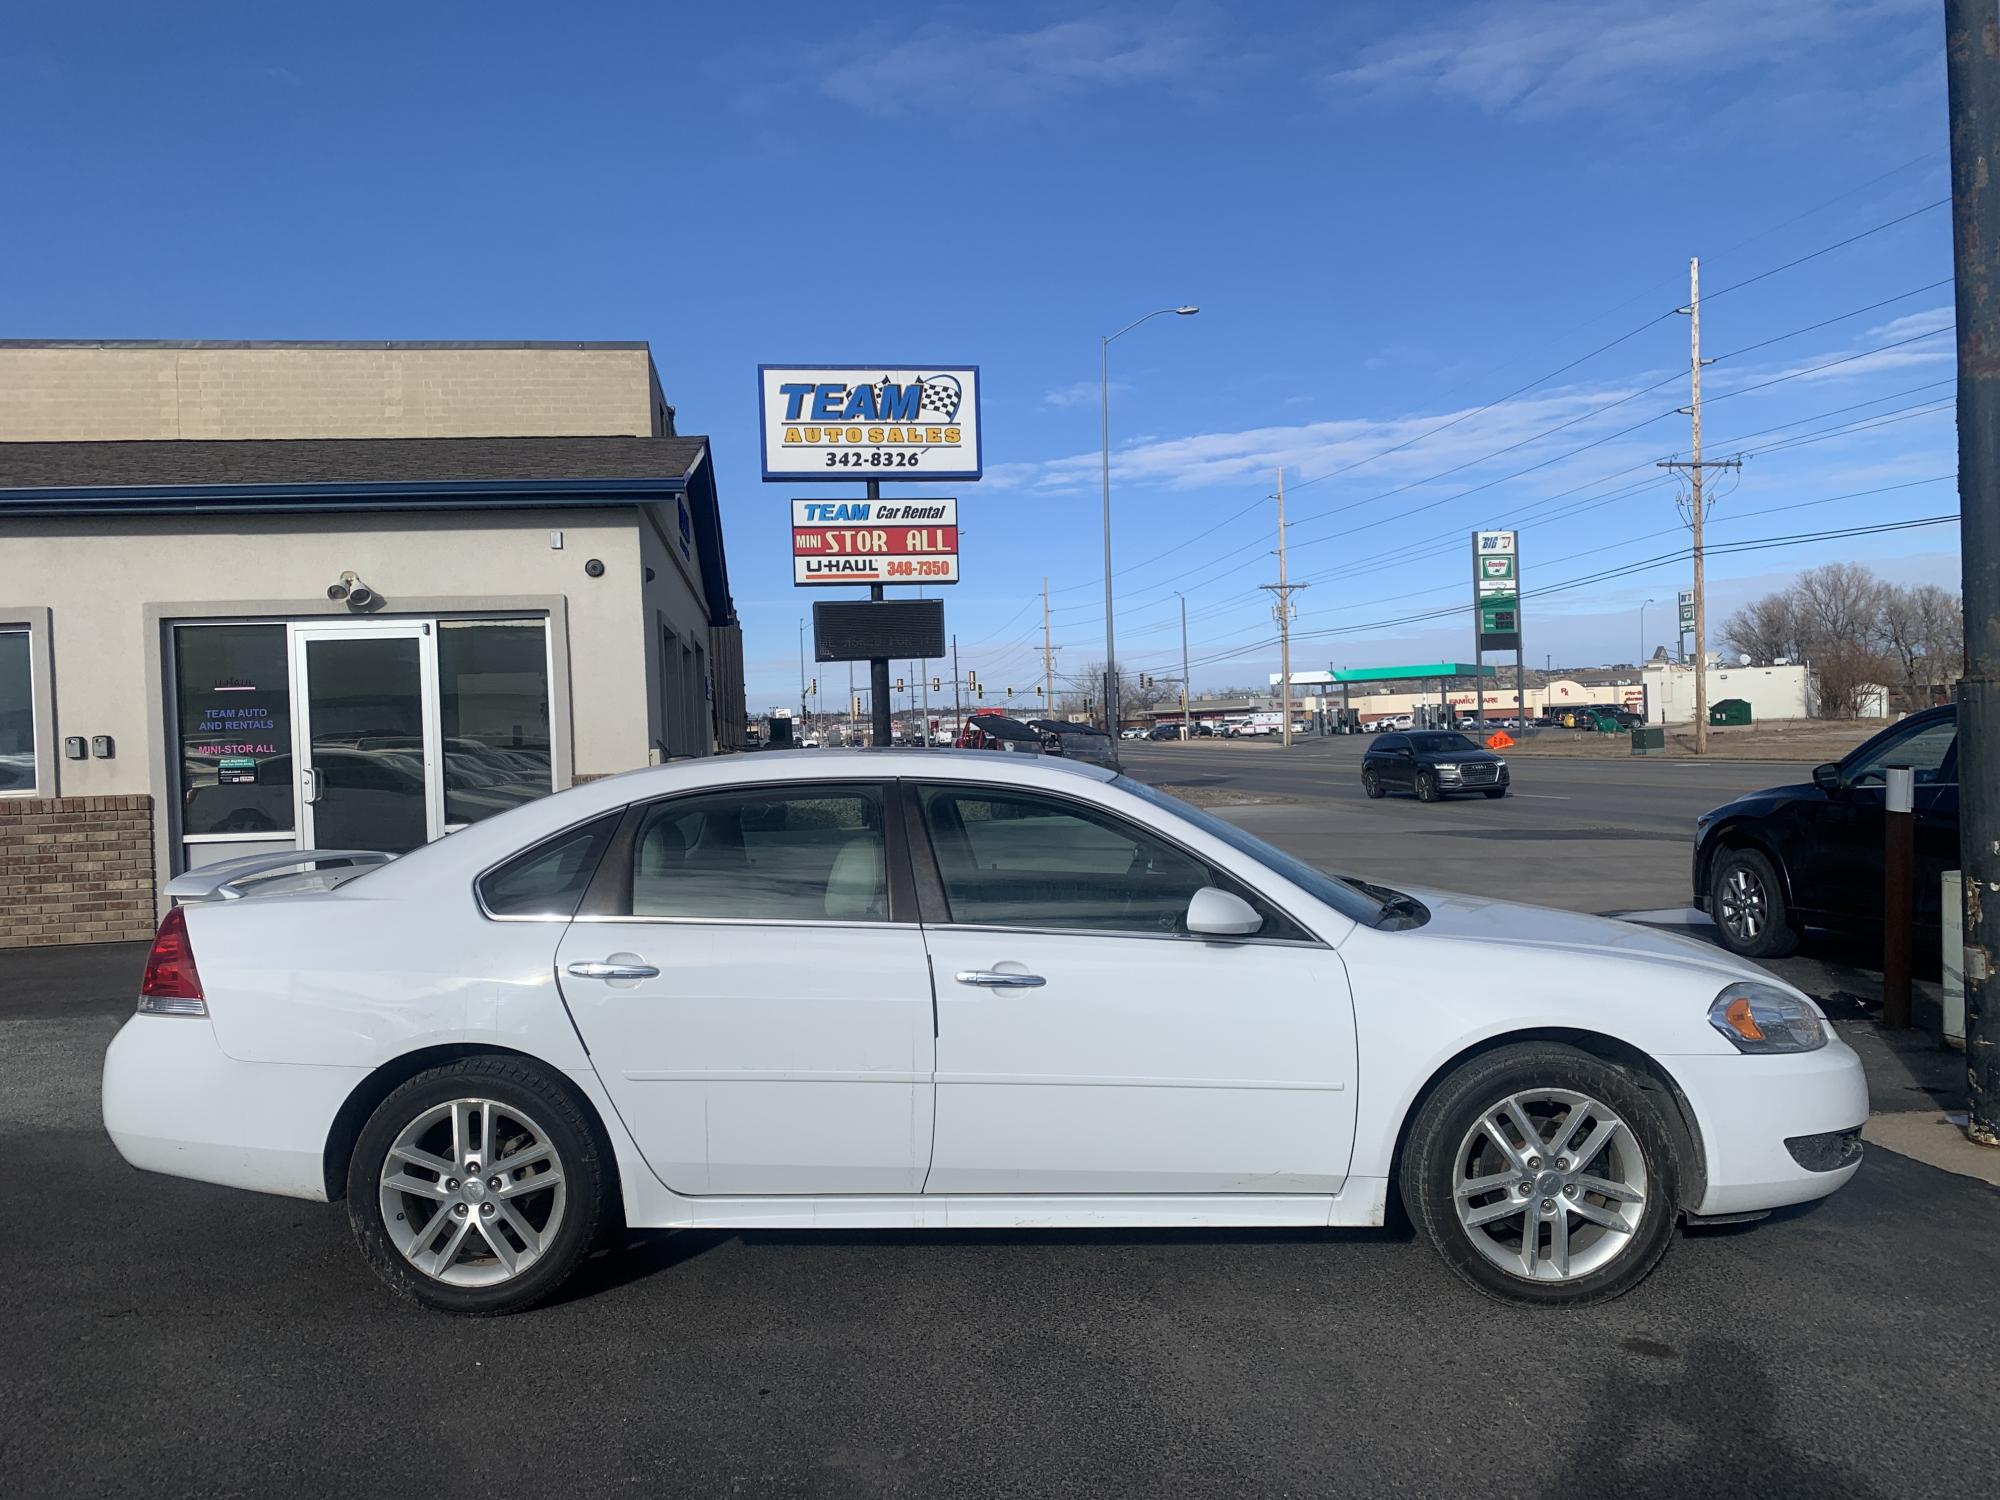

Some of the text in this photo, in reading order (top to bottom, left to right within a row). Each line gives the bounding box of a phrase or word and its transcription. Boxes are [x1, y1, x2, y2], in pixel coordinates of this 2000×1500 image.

[780, 382, 924, 421] TEAM
[825, 452, 919, 467] 342-8326
[804, 503, 946, 521] TEAM Car Rental
[796, 529, 951, 552] MINI STOR ALL
[1482, 537, 1498, 548] BIG
[806, 559, 949, 576] U-HAUL 348-7350
[205, 709, 268, 718] TEAM AUTO
[200, 721, 274, 730] AND RENTALS
[198, 745, 276, 754] MINI-STOR ALL
